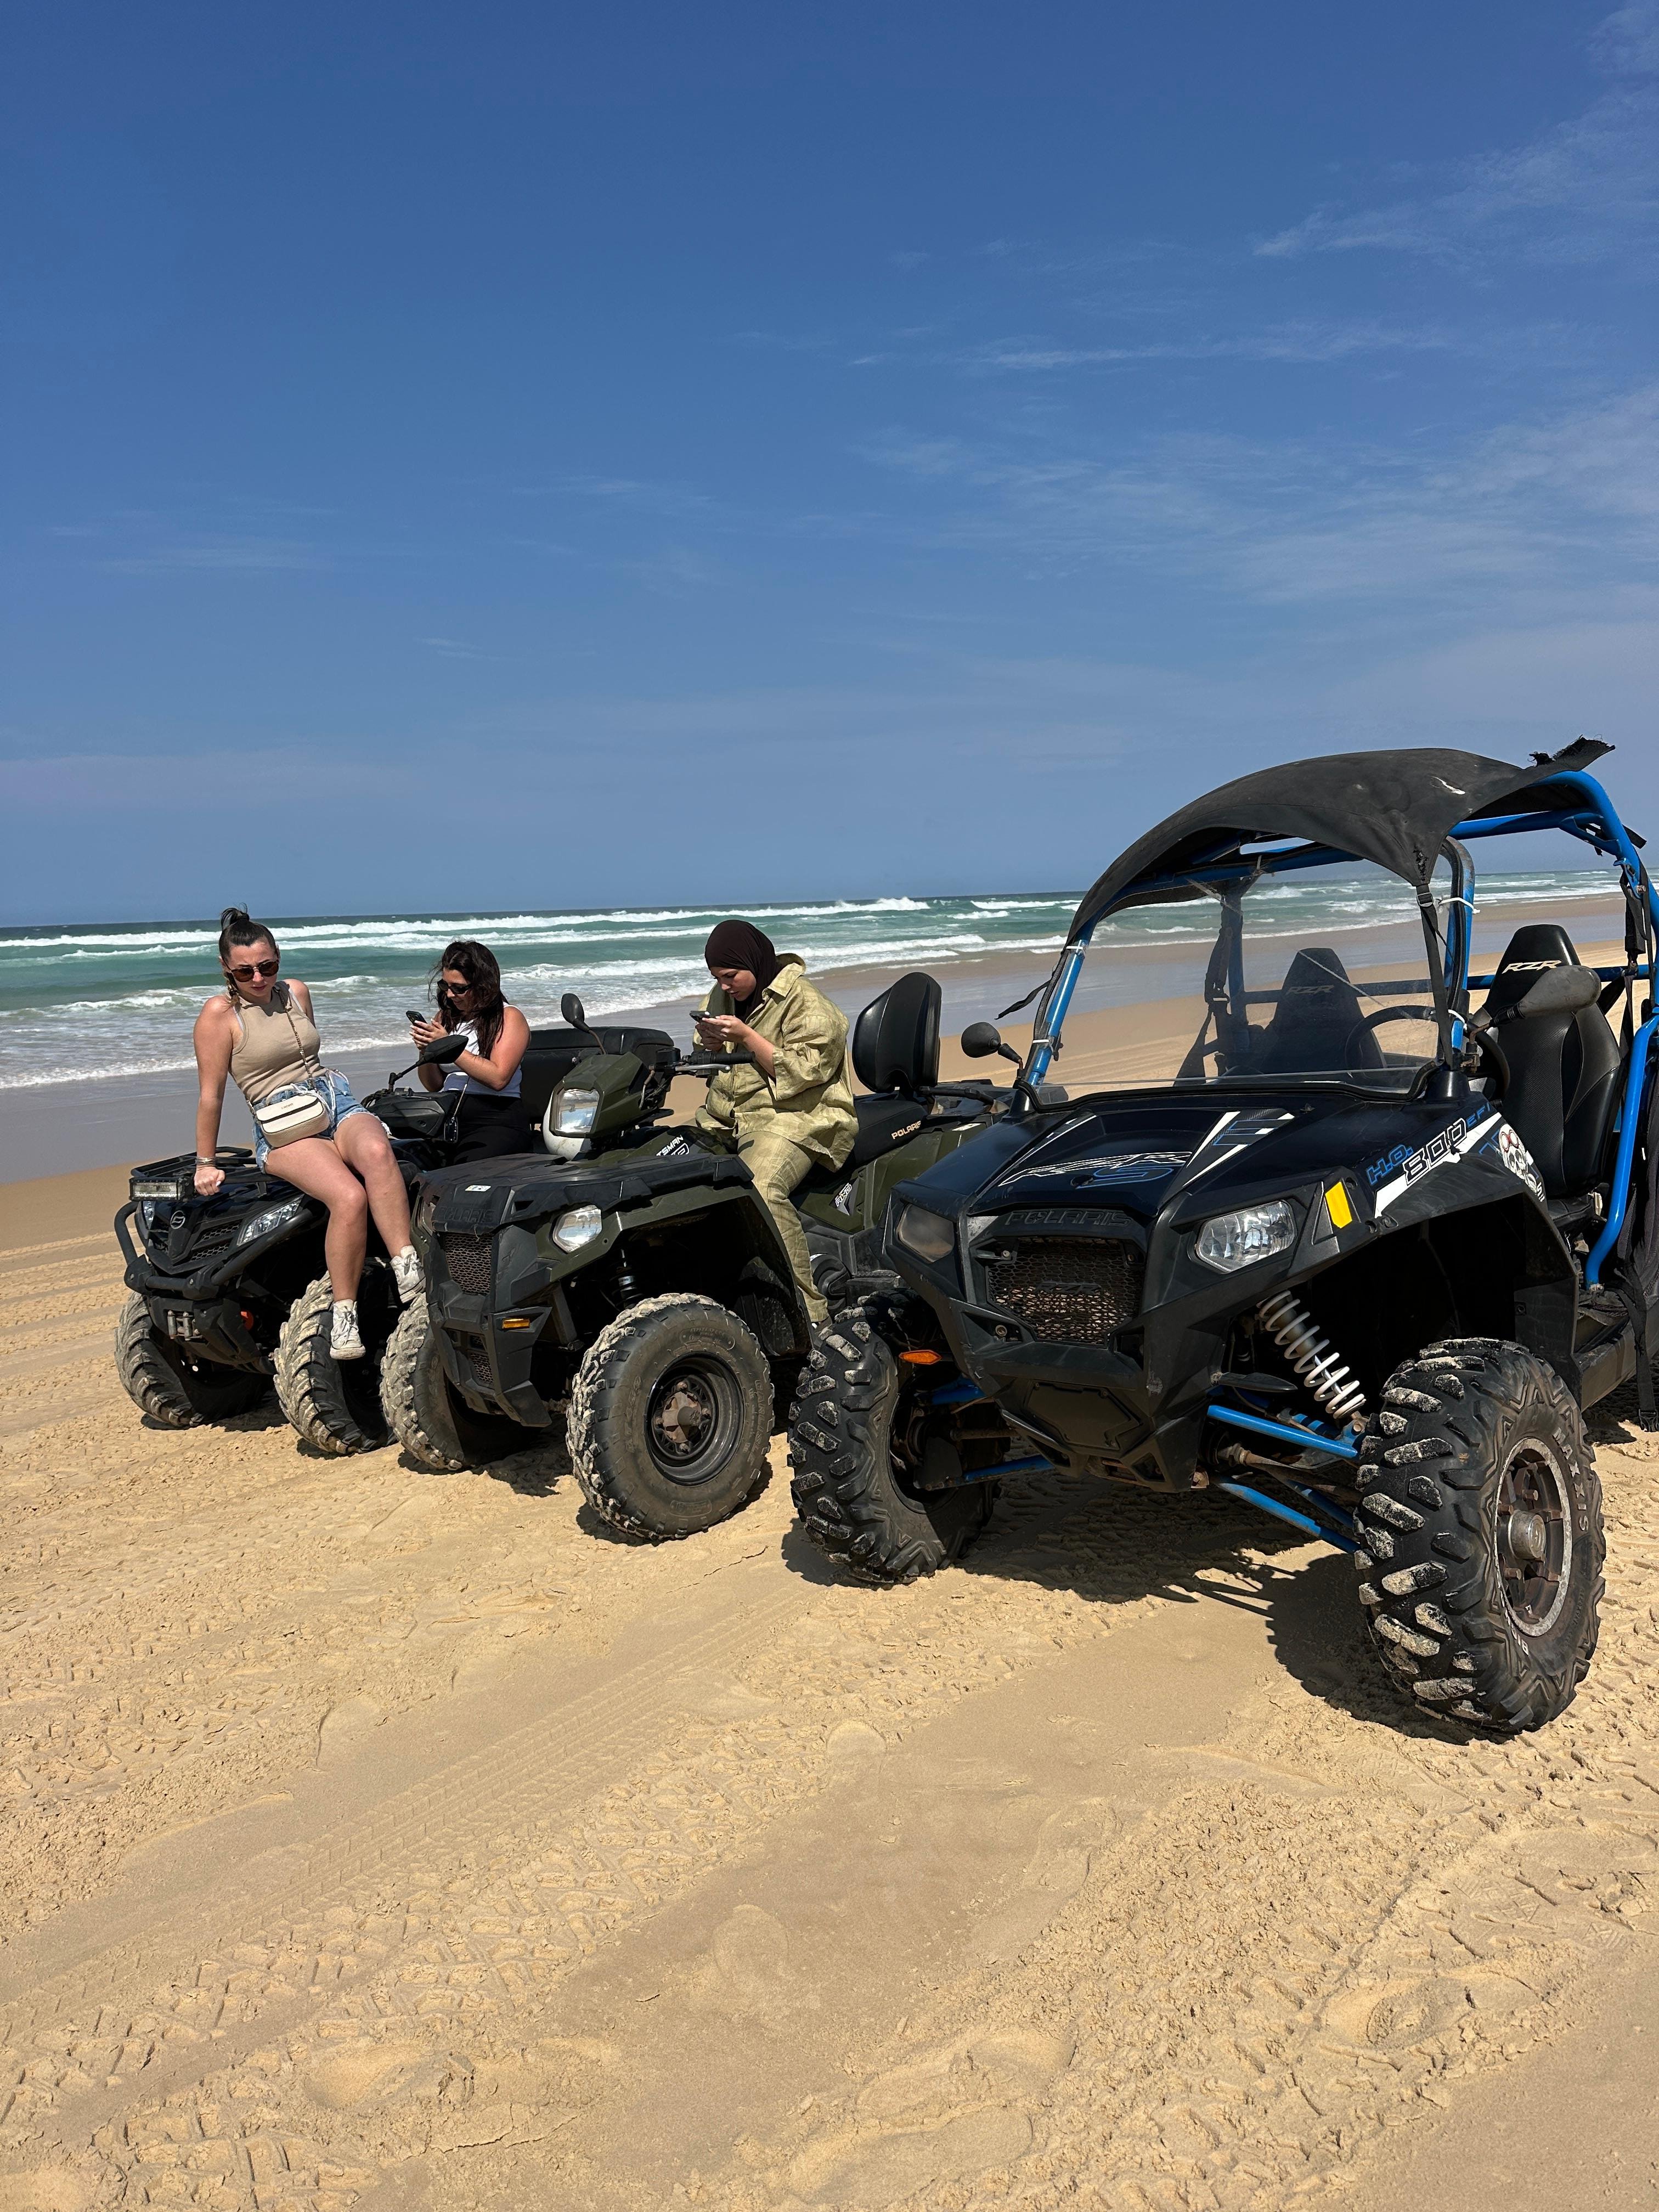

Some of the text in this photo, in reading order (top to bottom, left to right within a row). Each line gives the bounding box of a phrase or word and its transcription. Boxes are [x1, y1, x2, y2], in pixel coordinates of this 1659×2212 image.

[1501, 960, 1562, 974] RZR
[1285, 985, 1334, 995] RZR
[891, 1120, 921, 1139] POLARIS
[656, 1134, 684, 1156] TSMAN
[1402, 1118, 1467, 1186] 800
[1466, 1102, 1491, 1127] EFI
[997, 1152, 1193, 1187] RZR
[1005, 1210, 1135, 1226] POLARIS
[1034, 1281, 1102, 1295] RZR
[1552, 1427, 1589, 1532] MAXXIS
